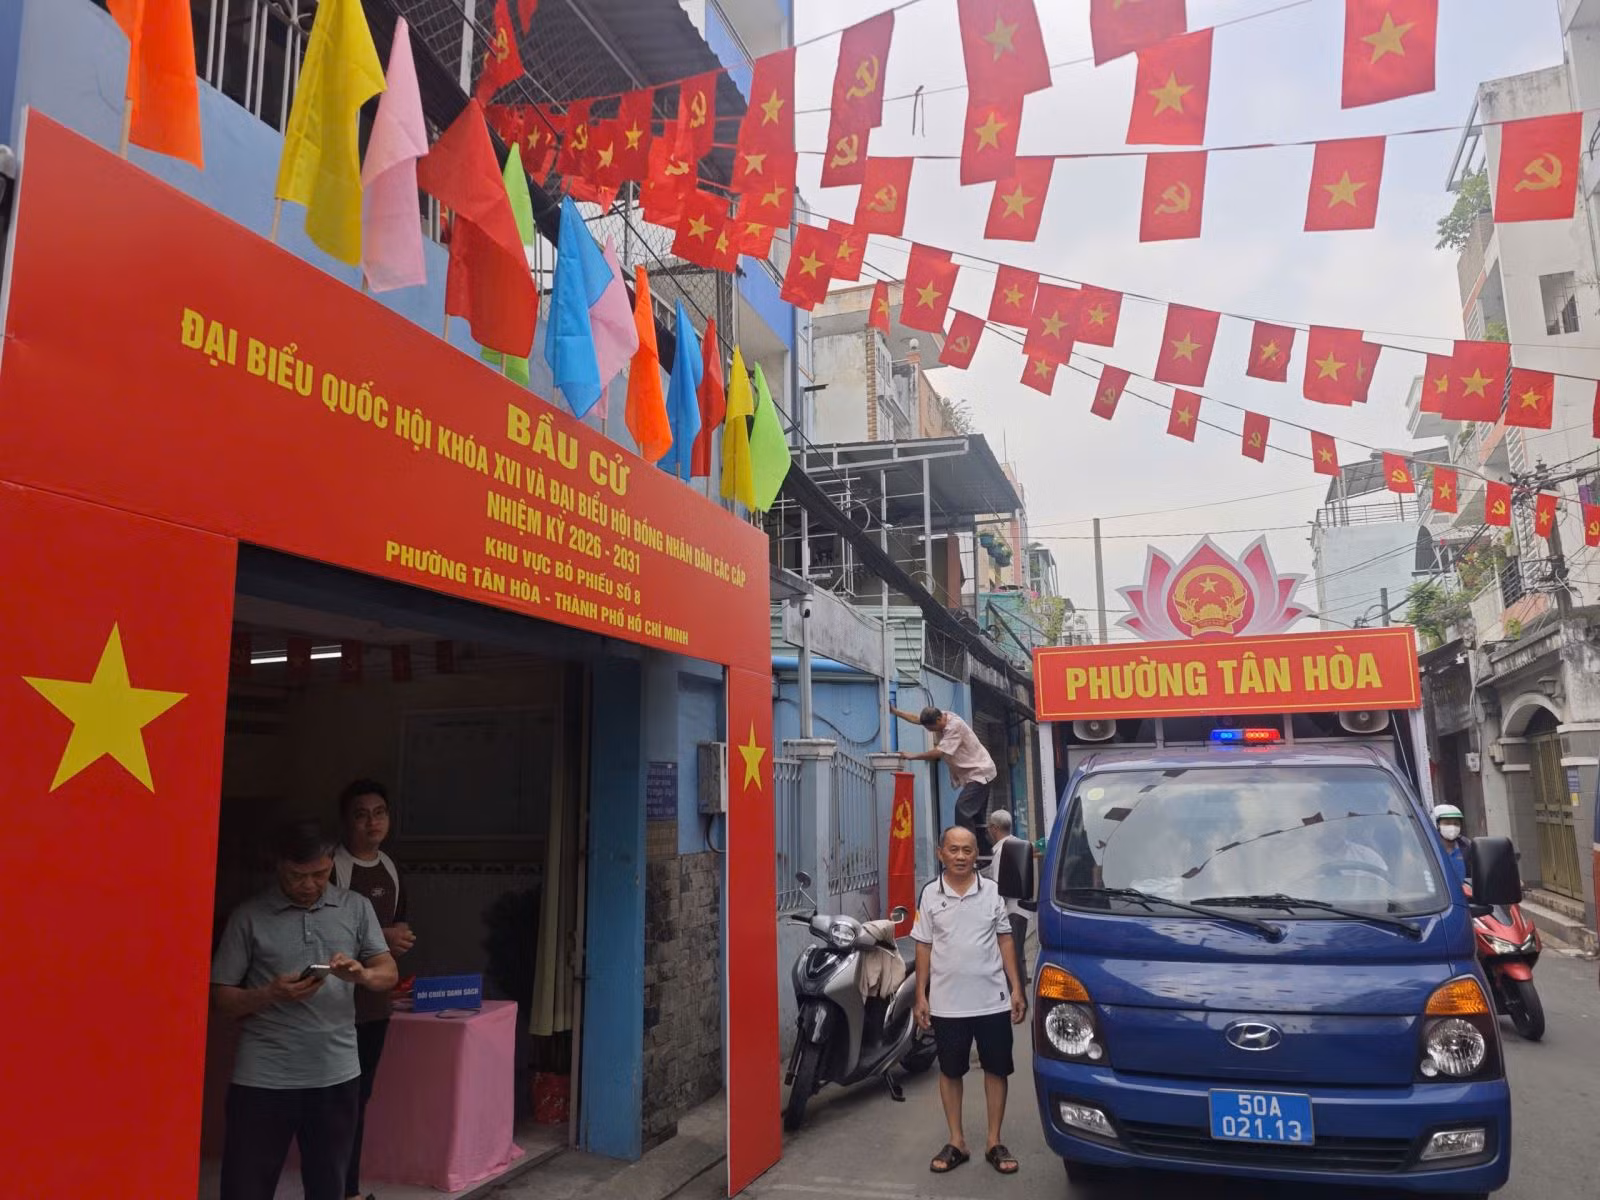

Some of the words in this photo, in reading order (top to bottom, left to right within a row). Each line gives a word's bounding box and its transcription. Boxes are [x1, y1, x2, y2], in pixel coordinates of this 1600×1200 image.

[181, 307, 238, 367] ĐẠI
[247, 337, 314, 396] BIỂU
[322, 373, 389, 429] QUỐC
[395, 405, 432, 451] HỘI
[437, 425, 489, 475] KHÓA
[493, 452, 521, 489] XVI
[526, 466, 546, 500] VÀ
[550, 479, 574, 516] ĐẠI
[578, 491, 608, 527] BIỂU
[611, 508, 631, 540] HỘI
[665, 534, 693, 565] NHÂN
[694, 546, 713, 574] DÂN
[714, 556, 730, 582] CÁC
[507, 403, 579, 470] BẦU
[588, 450, 631, 496] CỬ
[485, 536, 518, 564] KHU
[523, 549, 551, 575] VỰC
[555, 559, 574, 582] BỎ
[577, 568, 614, 596] PHIẾU
[616, 582, 632, 602] SỐ
[634, 589, 641, 606] 8
[487, 490, 542, 536] NHIỆM
[546, 514, 566, 545] KỲ
[568, 524, 602, 560] 2026
[613, 544, 641, 575] 2031
[385, 540, 467, 584] PHƯỜNG
[472, 566, 506, 594] TÂN
[510, 578, 541, 604] HÒA
[554, 592, 598, 620] THÀNH
[601, 606, 625, 628] PHỐ
[645, 620, 662, 638] CHÍ
[664, 625, 689, 645] MINH
[1065, 655, 1209, 700] PHƯỜNG
[1217, 651, 1292, 695] TÂN
[1302, 645, 1383, 692] HÒA
[1222, 1116, 1302, 1141] 021.13
[1238, 1094, 1282, 1117] 50A
